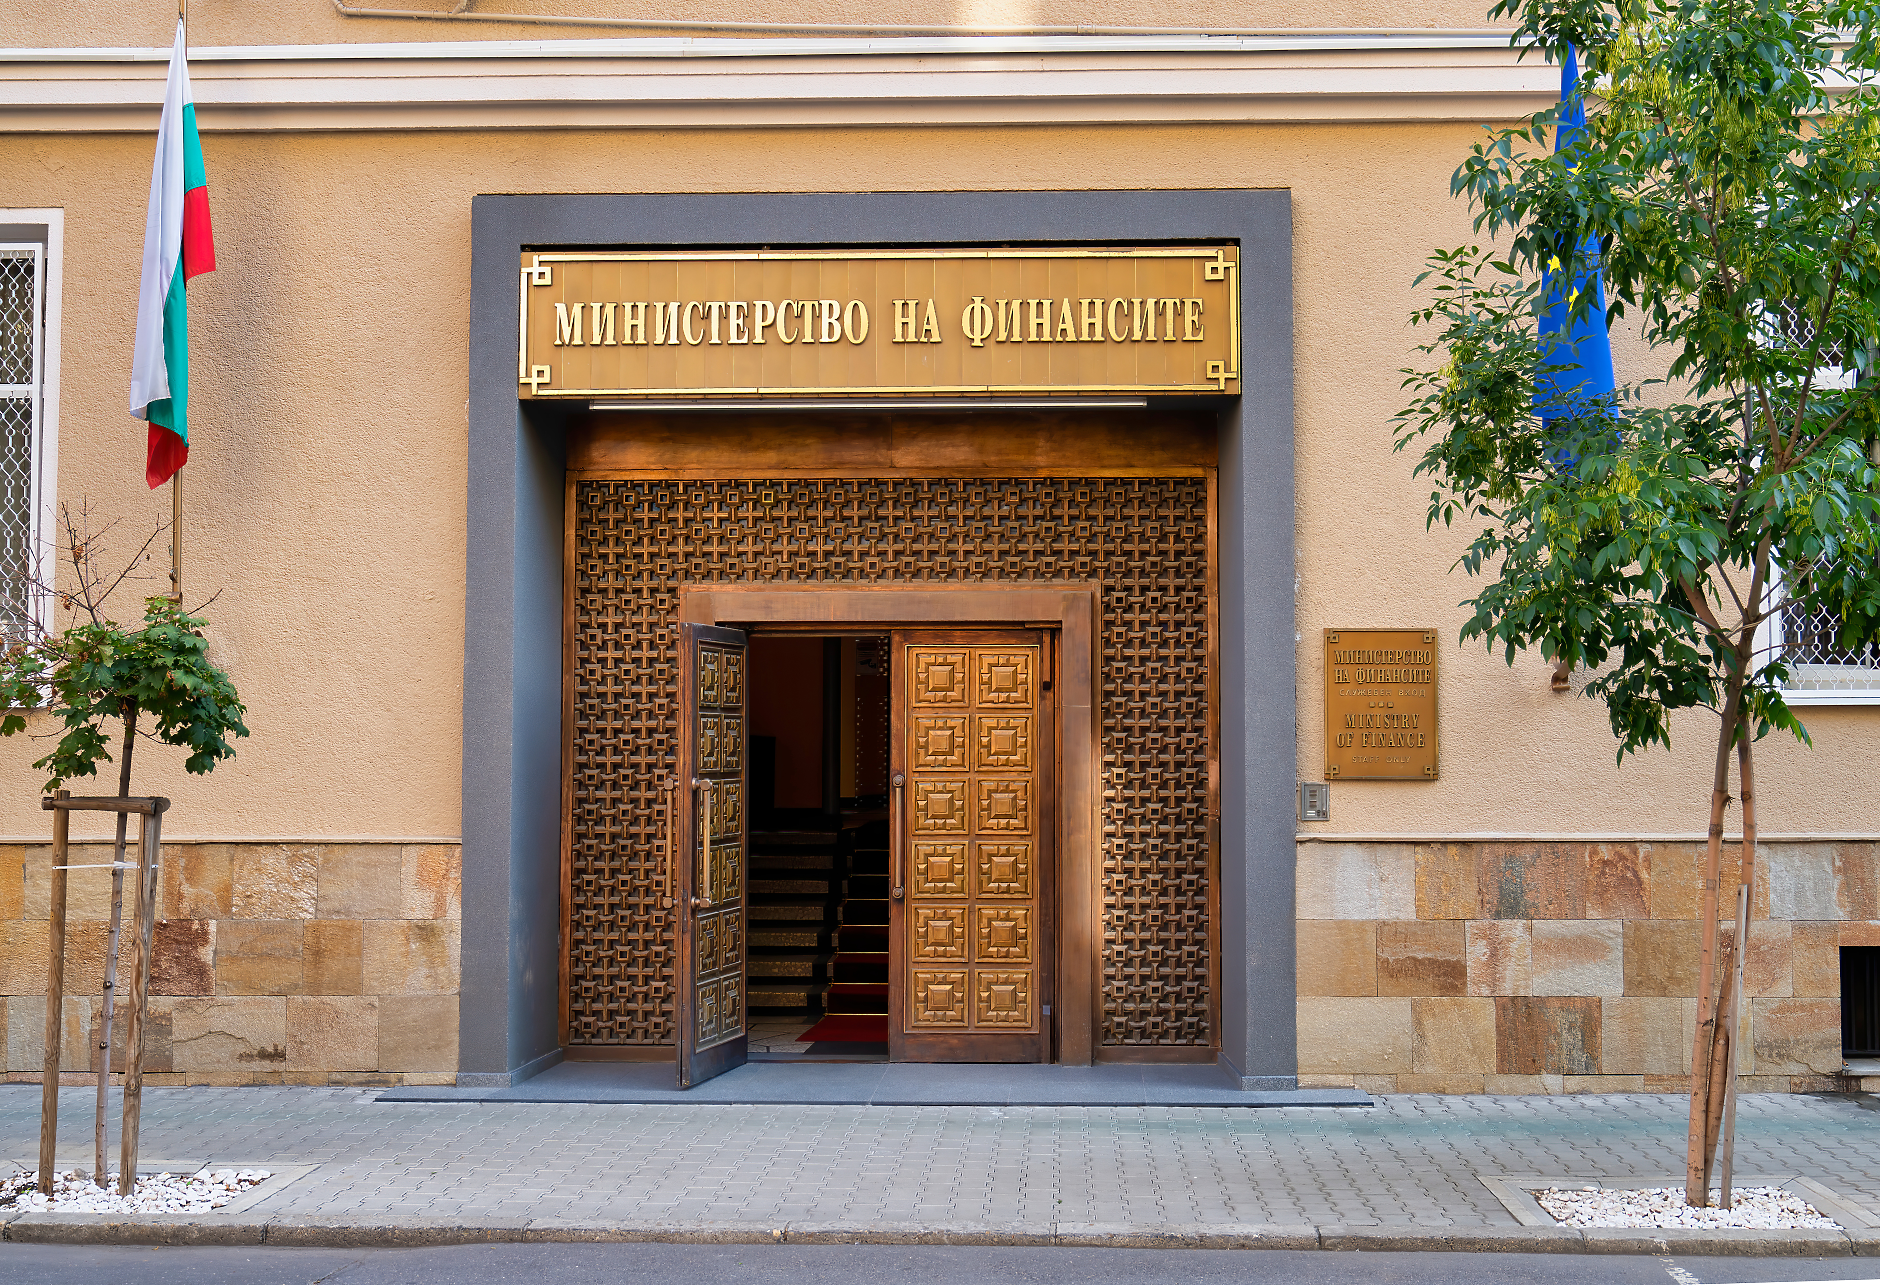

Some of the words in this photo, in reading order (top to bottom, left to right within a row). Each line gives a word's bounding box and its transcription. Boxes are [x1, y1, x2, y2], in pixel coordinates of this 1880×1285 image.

[553, 299, 869, 346] МИНИСТЕРСТВО
[892, 298, 942, 343] НА
[961, 295, 1204, 347] ФИНАНСИТЕ
[1334, 649, 1432, 665] МИНИСТЕРСТВО
[1334, 668, 1351, 684] НА
[1355, 667, 1431, 684] ФИНАНСИТЕ
[1339, 688, 1392, 697] СЛУЖЕБЕН
[1398, 688, 1426, 698] ВХОД
[1345, 713, 1420, 729] MINISTRY
[1336, 732, 1354, 748] OF
[1361, 732, 1425, 748] FINANCE
[1352, 755, 1380, 763] STAFF
[1385, 755, 1411, 763] ONLY
